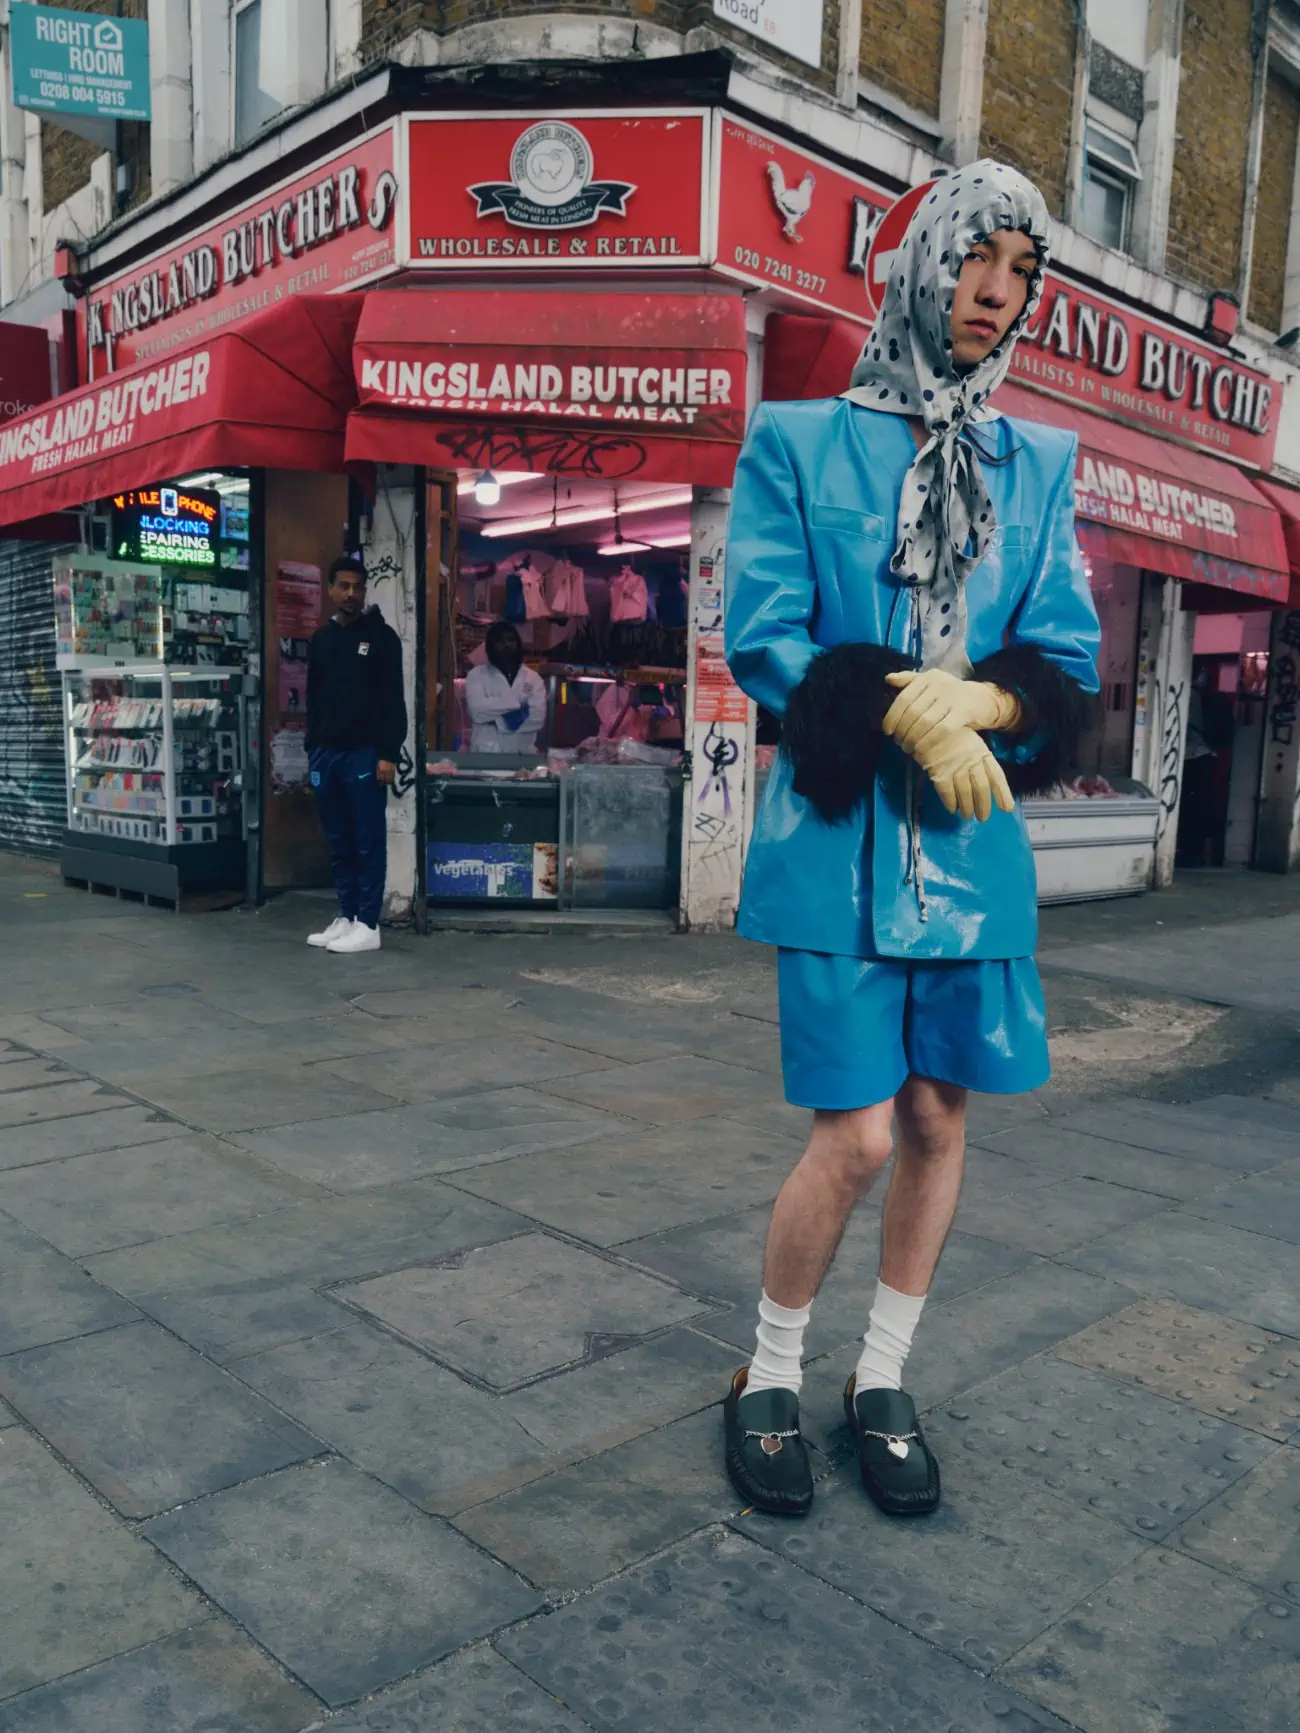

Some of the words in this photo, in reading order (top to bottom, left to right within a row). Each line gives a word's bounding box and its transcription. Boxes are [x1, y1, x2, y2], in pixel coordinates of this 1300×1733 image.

[35, 16, 92, 47] RIGHT
[69, 45, 125, 77] ROOM
[71, 86, 94, 104] 004
[96, 89, 126, 107] 5915
[508, 206, 529, 220] FRESH
[560, 206, 593, 223] LONDON
[558, 200, 588, 215] QUALITY
[417, 236, 562, 257] WHOLESALE
[568, 236, 589, 256] &
[595, 235, 683, 256] RETAIL
[274, 281, 285, 301] &
[286, 261, 330, 296] RETAIL
[734, 245, 760, 270] 020
[764, 256, 793, 283] 7241
[796, 268, 828, 295] 3277
[87, 243, 218, 347] KNGSLAND
[95, 350, 211, 433] BUTCHER
[361, 358, 564, 401] KINGSLAND
[571, 365, 734, 405] BUTCHER
[1138, 330, 1273, 437] BUTCHE
[500, 400, 603, 417] HALAL
[613, 403, 699, 425] MEAT
[1080, 374, 1096, 397] IN
[1100, 383, 1176, 426] WHOLESALE
[1193, 419, 1232, 448] RETAIL
[30, 450, 62, 475] FRESH
[63, 434, 99, 464] HALAL
[100, 421, 135, 451] MEAT
[178, 495, 217, 521] PHONE
[1109, 502, 1151, 532] HALAL
[1151, 515, 1183, 541] MEAT
[1135, 473, 1239, 538] BUTCHER
[139, 515, 210, 535] NLOCKING
[139, 530, 210, 551] EPAIRING
